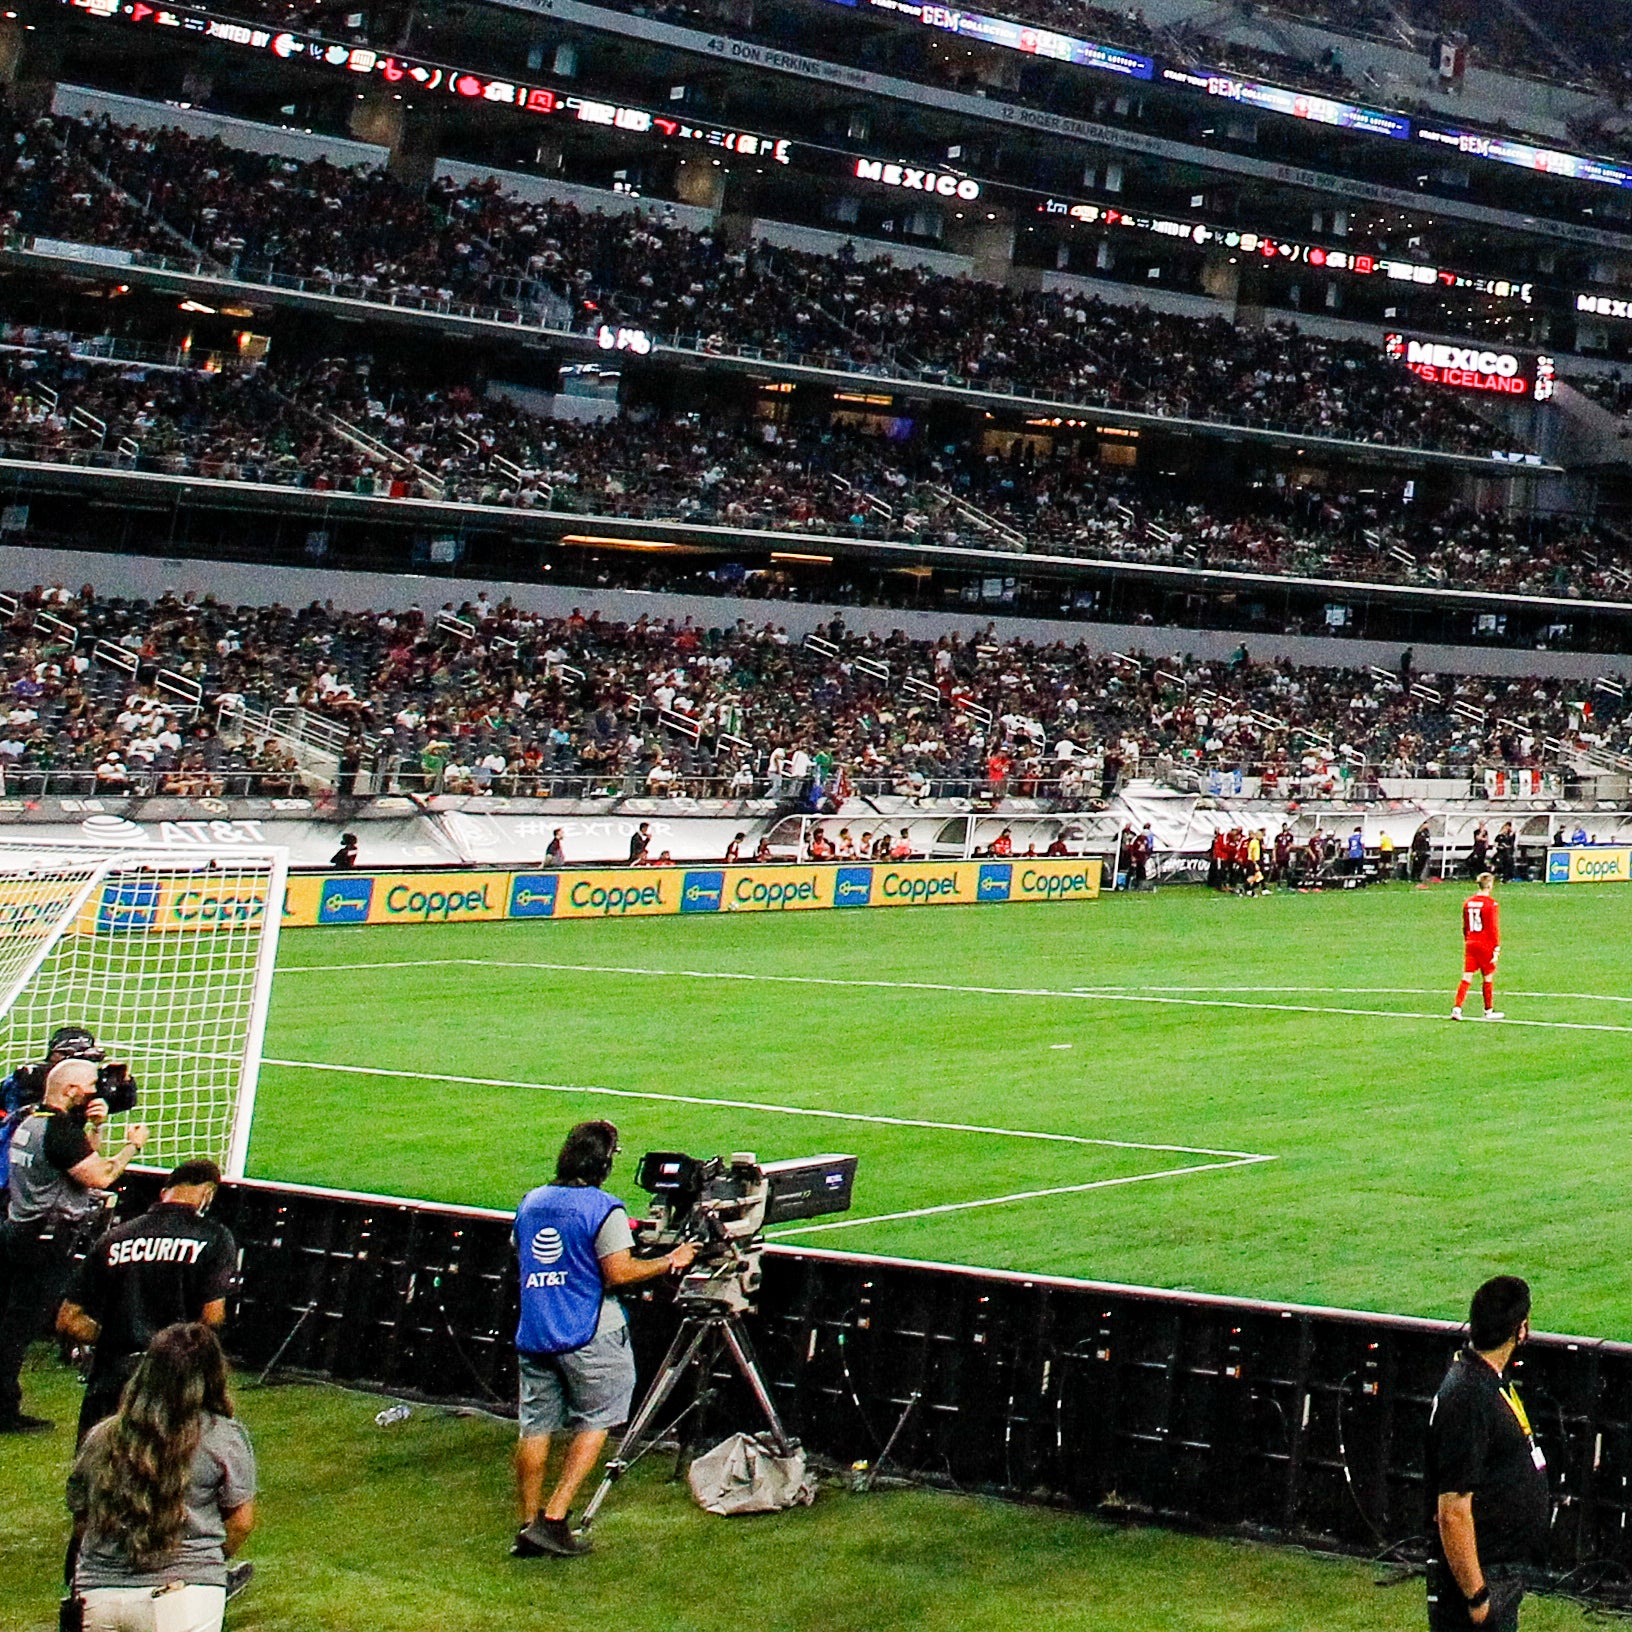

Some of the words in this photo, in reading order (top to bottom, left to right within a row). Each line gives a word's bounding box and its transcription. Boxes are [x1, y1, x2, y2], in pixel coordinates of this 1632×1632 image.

[899, 2, 922, 16] YOUR
[920, 5, 961, 33] GEM
[707, 37, 725, 52] 43
[731, 43, 761, 62] DON
[765, 51, 821, 74] PERKINS
[1207, 77, 1243, 100] GEM
[1020, 110, 1059, 130] ROGER
[1061, 120, 1120, 143] STAUBACH
[1458, 135, 1489, 157] GEM
[854, 159, 979, 200] MEXICO
[1406, 341, 1519, 377] MEXICO
[1443, 369, 1527, 394] ICELAND
[159, 820, 266, 844] AT&T
[1575, 856, 1622, 876] Coppel
[570, 879, 663, 919] Coppel
[735, 872, 820, 911] Coppel
[881, 868, 960, 905] Coppel
[1021, 866, 1091, 901] Coppel
[171, 881, 296, 927] Coppl
[385, 883, 491, 920] Coppel
[1468, 908, 1483, 932] 13
[107, 1237, 208, 1266] SECURITY
[526, 1271, 569, 1289] AT&T
